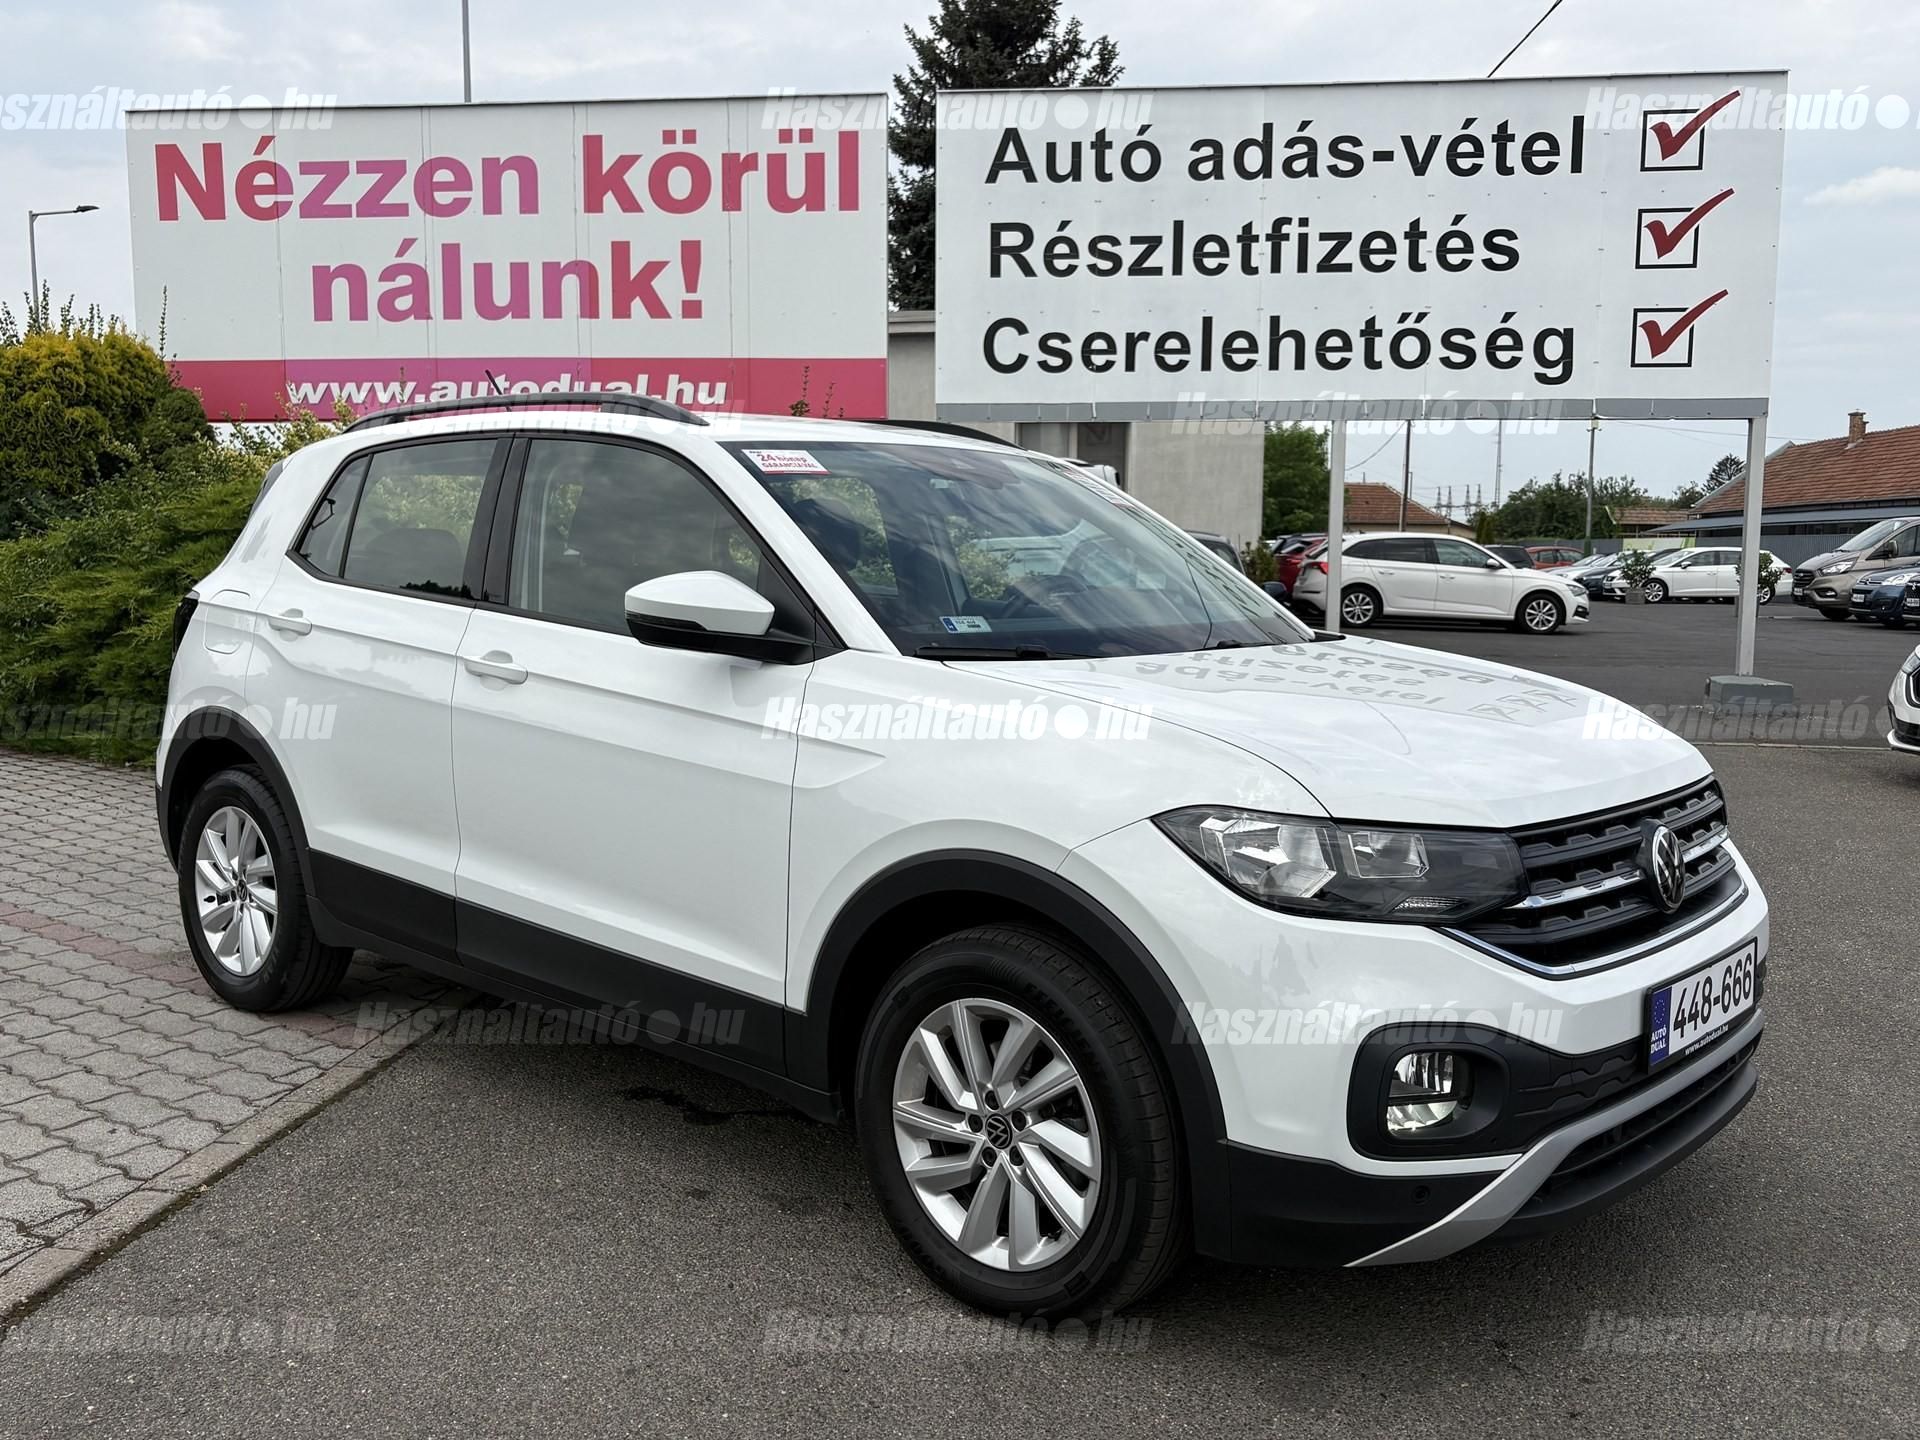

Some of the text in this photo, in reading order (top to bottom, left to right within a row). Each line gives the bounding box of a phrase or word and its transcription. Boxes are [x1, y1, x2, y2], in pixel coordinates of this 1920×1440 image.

[155, 129, 859, 221] Nézzen körül
[985, 115, 1585, 184] Autó adás-vétel
[312, 238, 702, 321] nálunk!
[989, 214, 1520, 278] Részletfizetés
[983, 312, 1575, 386] Cserelehetőség
[1673, 953, 1753, 1040] 448-666
[1650, 1024, 1668, 1043] AUTÓ
[1650, 1039, 1667, 1054] DUAL
